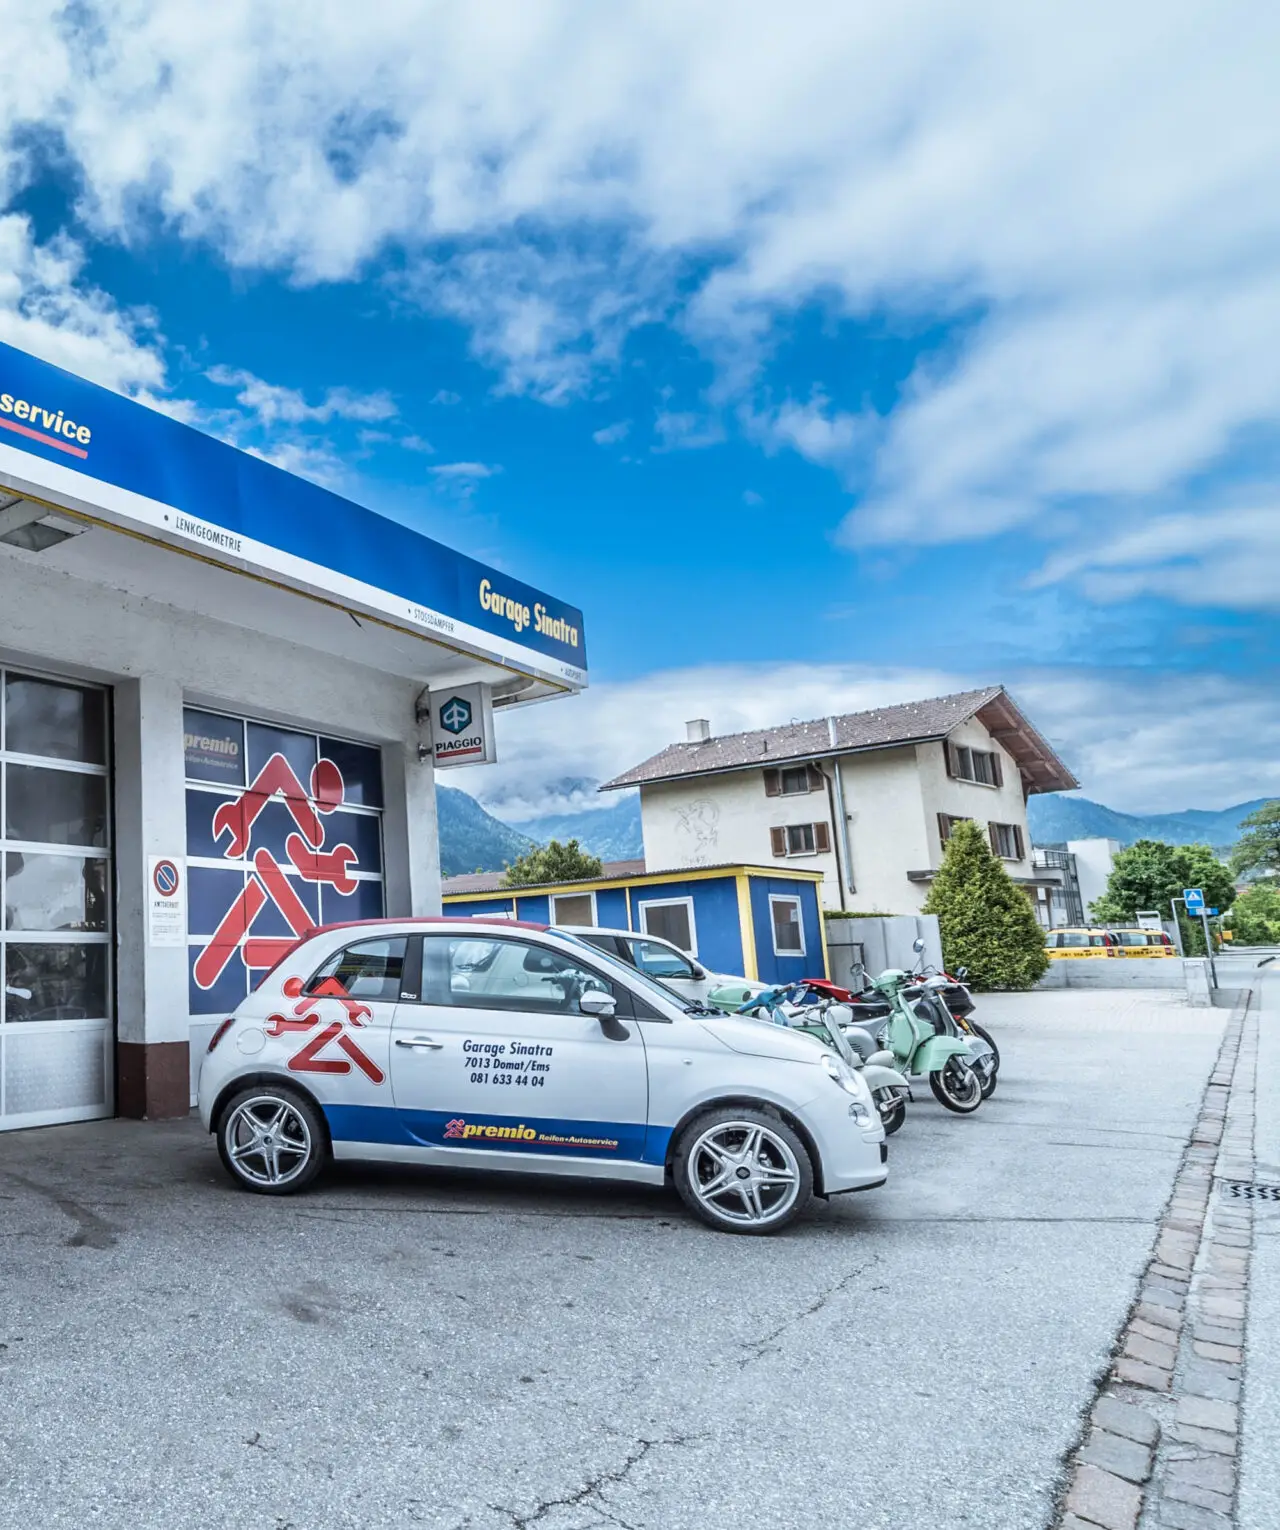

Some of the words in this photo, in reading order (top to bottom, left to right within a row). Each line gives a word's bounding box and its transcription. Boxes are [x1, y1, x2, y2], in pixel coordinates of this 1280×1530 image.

[176, 516, 242, 552] LENKGEOMETRIE
[479, 579, 530, 632] Garage
[534, 603, 578, 648] Sinatra
[184, 734, 239, 755] premio
[435, 737, 482, 752] PIAGGIO
[463, 1039, 505, 1057] Garage
[510, 1042, 553, 1056] Sinatra
[464, 1057, 491, 1069] 7013
[493, 1058, 550, 1072] Domat/Ems
[470, 1072, 489, 1084] 081
[492, 1074, 512, 1085] 633
[515, 1075, 528, 1086] 44
[531, 1076, 545, 1087] 04
[463, 1124, 537, 1140] premio
[539, 1134, 618, 1146] Reifen+Autoservice
